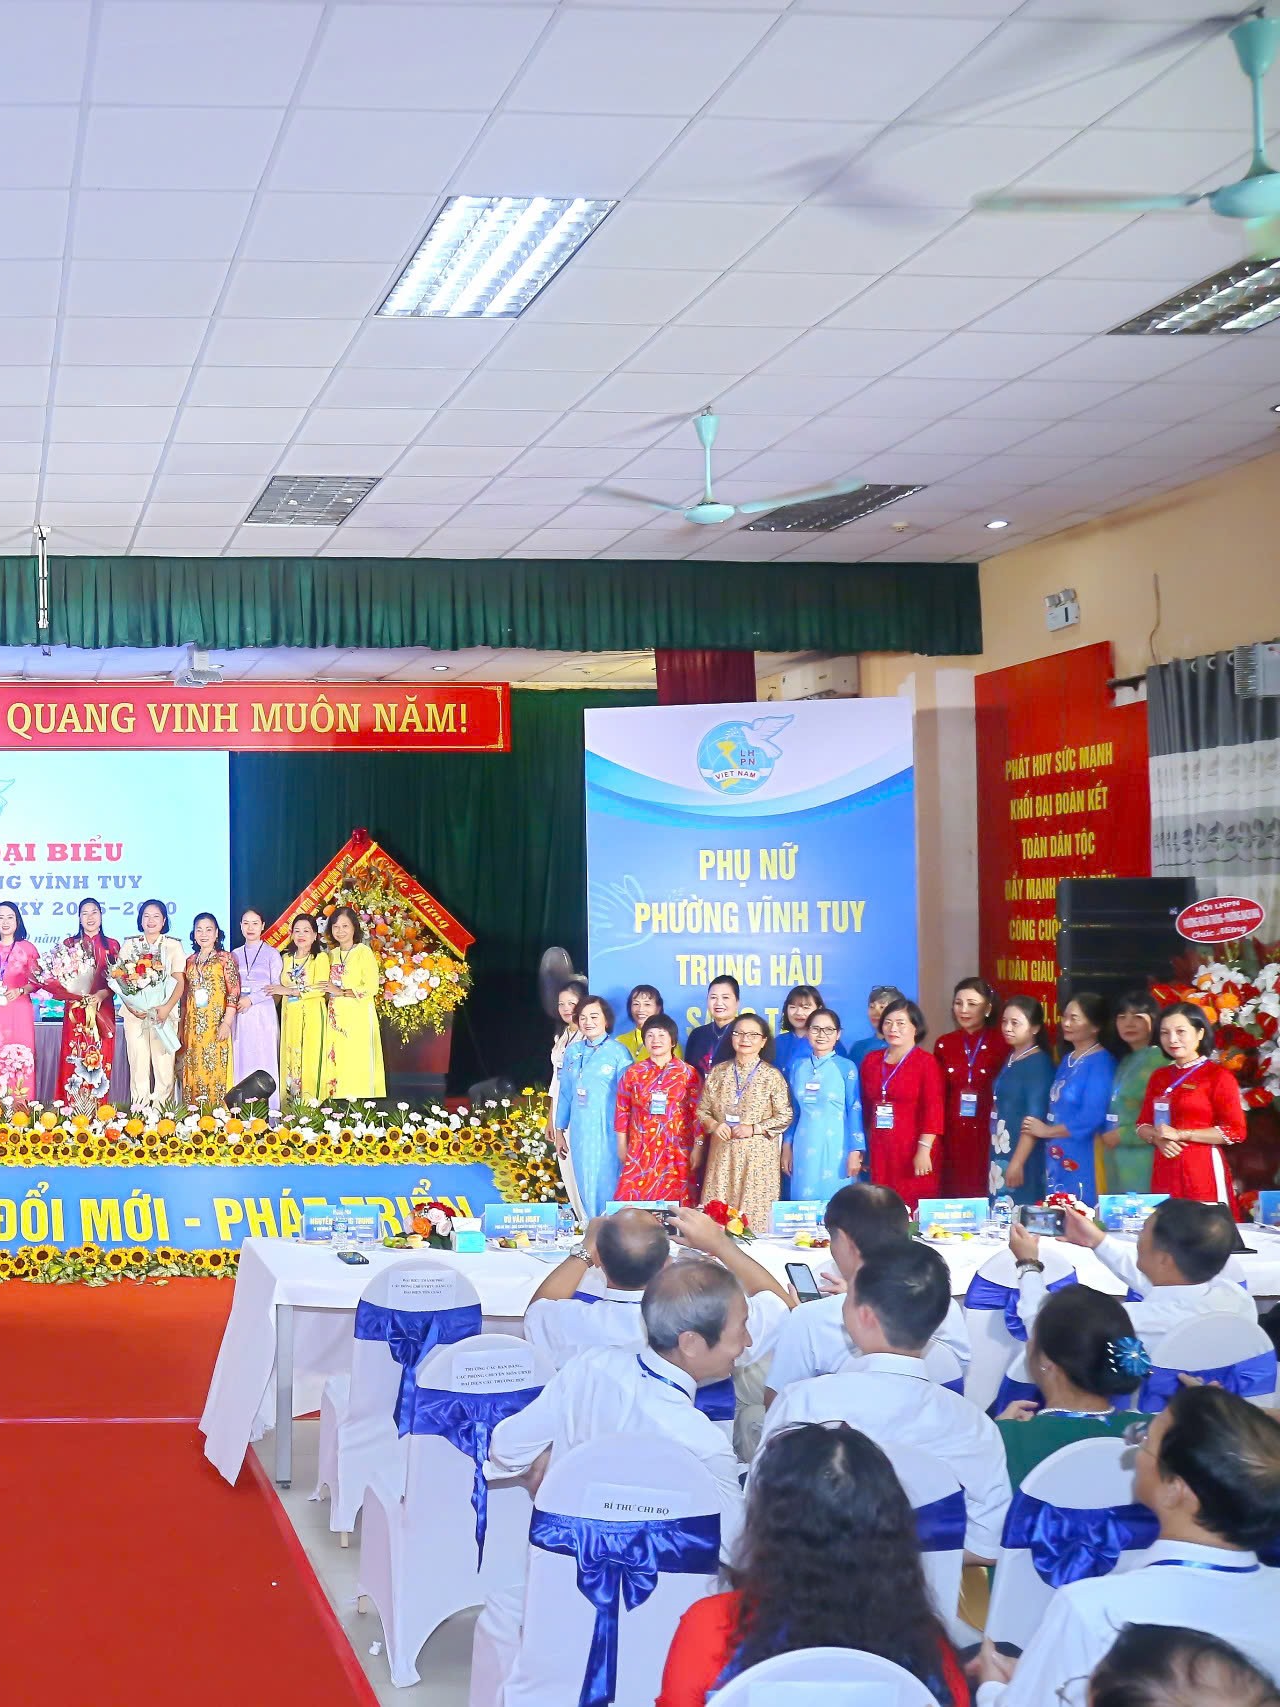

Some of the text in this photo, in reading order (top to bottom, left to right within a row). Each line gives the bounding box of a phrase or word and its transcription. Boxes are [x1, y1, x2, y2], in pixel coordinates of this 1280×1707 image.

[6, 702, 137, 740] QUANG
[147, 702, 239, 733] VINH
[250, 693, 360, 733] MUÔN
[372, 694, 468, 733] NĂM!
[1005, 742, 1113, 781] PHÁT HUY SỨC MẠNH
[1010, 779, 1108, 821] KHỐI ĐẠI ĐOÀN KẾT
[47, 834, 124, 862] BIỂU
[1022, 827, 1096, 860] TOÀN DÂN TỘC
[699, 841, 799, 888] PHỤ NỮ
[29, 873, 89, 890] VĨNH
[97, 875, 143, 890] TUY
[1005, 871, 1056, 905] ĐẨY MẠNH
[634, 894, 866, 934] PHƯỜNG VĨNH TUY
[1009, 915, 1036, 941] CÔNG
[34, 934, 61, 944] năm
[676, 954, 761, 986] TRUNG
[1008, 956, 1028, 981] DÂN
[80, 1188, 170, 1242] MỚI
[616, 1503, 637, 1512] THƯ
[637, 1505, 654, 1513] CHI
